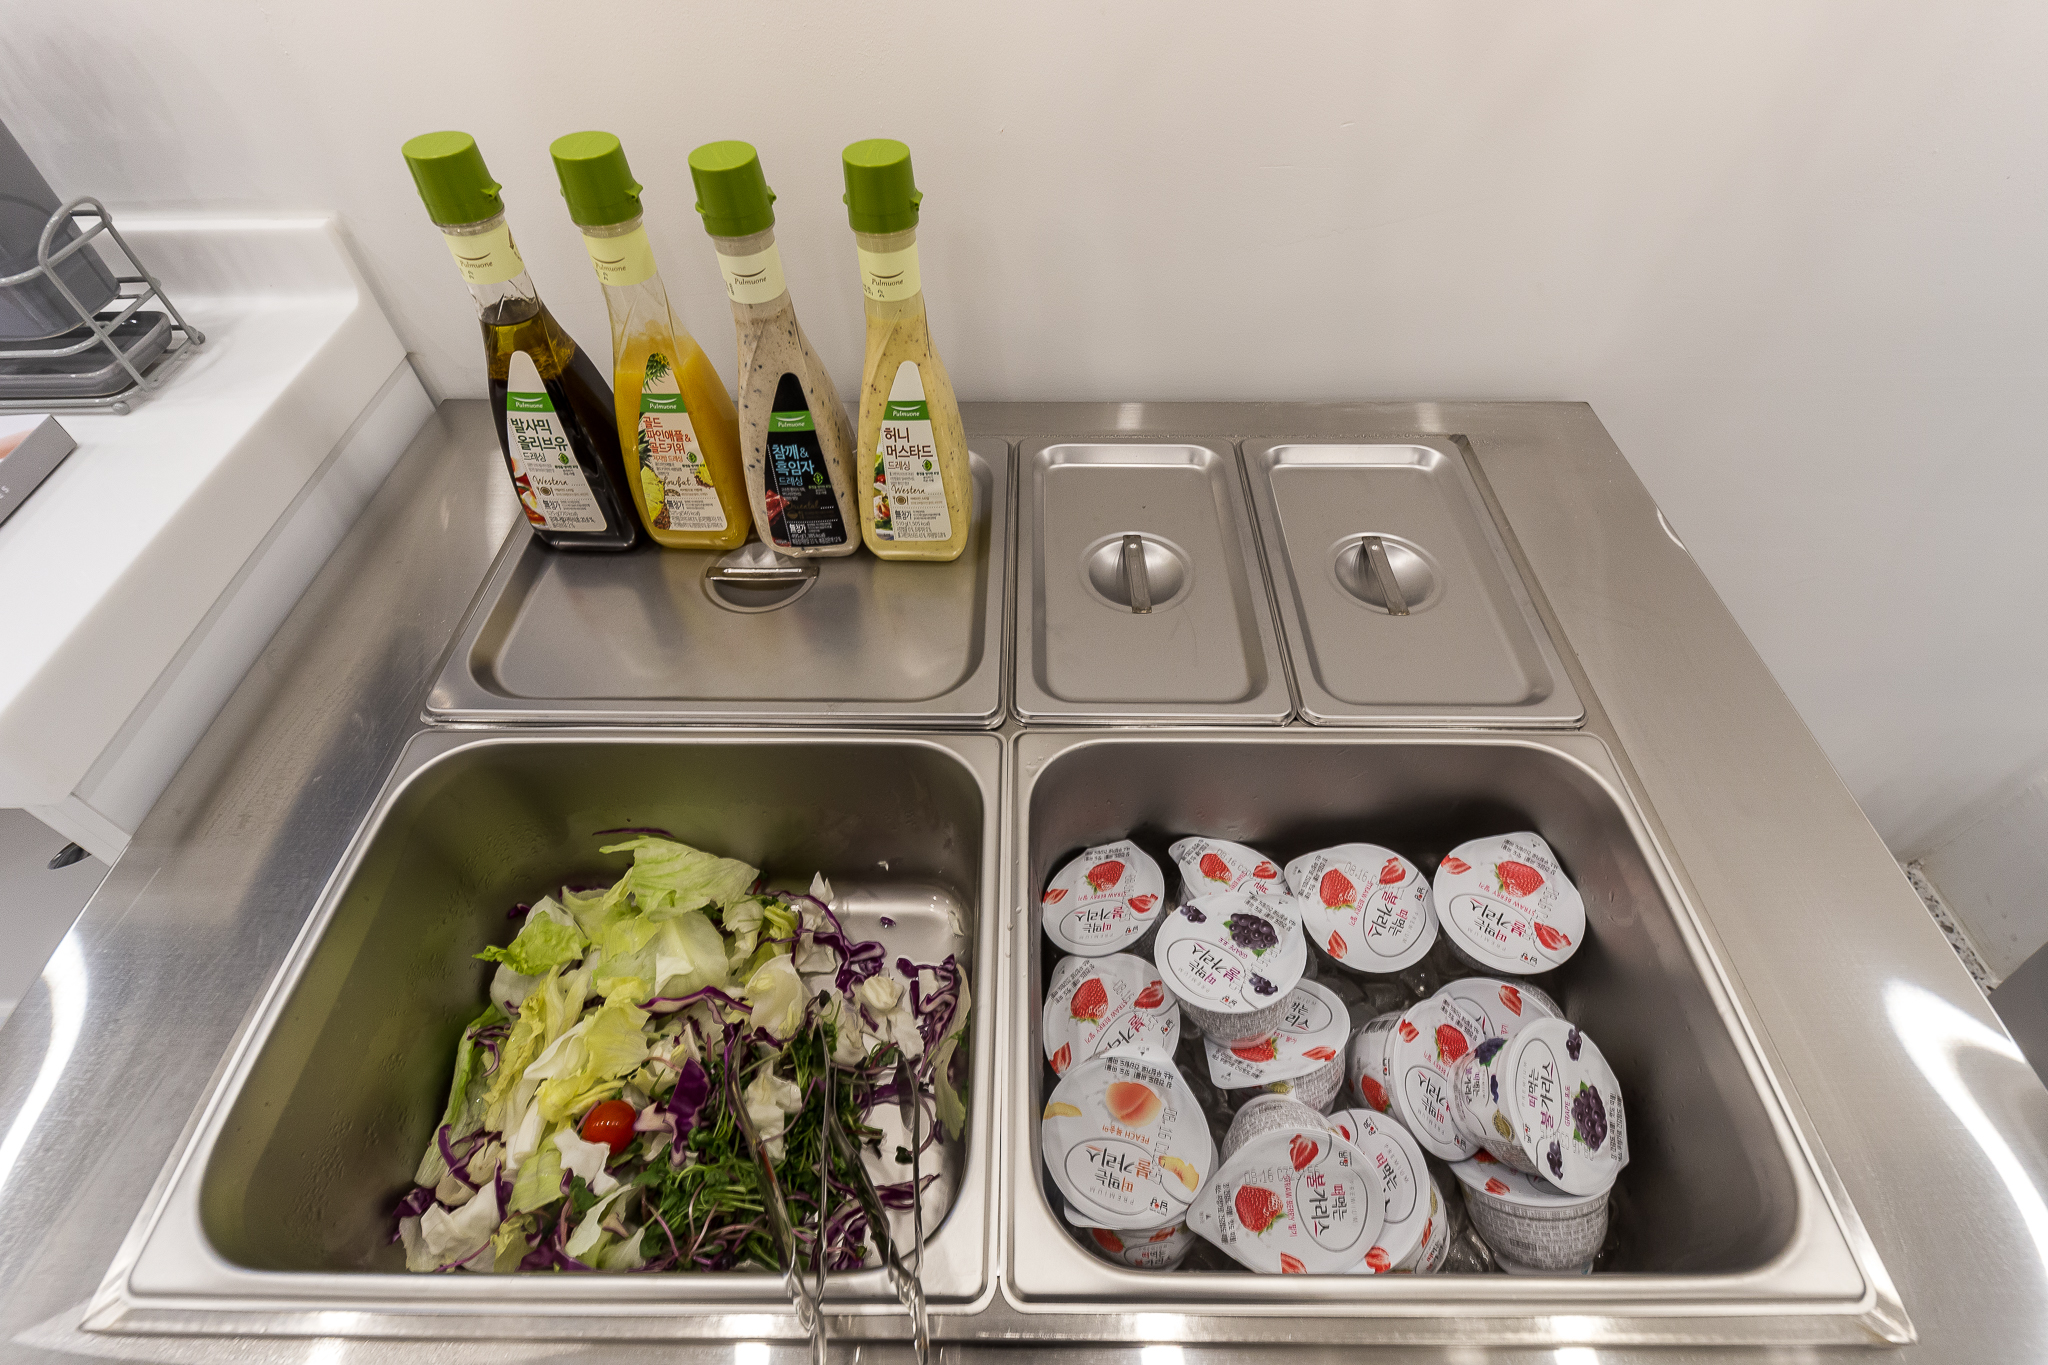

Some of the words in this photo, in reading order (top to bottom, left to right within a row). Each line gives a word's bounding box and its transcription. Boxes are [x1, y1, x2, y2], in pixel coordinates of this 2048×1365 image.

[734, 277, 766, 285] Pulmuone
[510, 418, 552, 434] 발사믹
[643, 417, 663, 429] 골드
[518, 436, 568, 451] 올리브유
[884, 428, 910, 443] 허니
[523, 452, 546, 462] 드레싱
[650, 442, 685, 454] 골드키위
[886, 445, 933, 460] 머스타드
[776, 460, 814, 475] 흑임자
[888, 461, 910, 470] 드레싱
[532, 475, 568, 486] Western
[779, 476, 803, 486] 드레싱
[891, 484, 925, 494] Western
[1073, 906, 1123, 921] 불가리스
[1368, 891, 1398, 936] 불가리스
[1387, 908, 1408, 935] 떠먹는
[1470, 898, 1526, 937] 불가리스
[1474, 916, 1506, 941] 떠먹는
[1192, 942, 1240, 981] 불가리스
[1189, 960, 1216, 985] 떠먹는
[1283, 1012, 1311, 1031] 리스
[1418, 1071, 1448, 1104] 가리스
[1527, 1067, 1538, 1107] 떠먹는
[1540, 1061, 1553, 1129] 불가리스
[1421, 1094, 1444, 1123] 떠먹는
[1124, 1130, 1150, 1144] PEACH
[1085, 1145, 1152, 1179] 불가리스
[1376, 1152, 1396, 1191] 떠먹는
[1094, 1168, 1134, 1192] 떠먹는
[1088, 1186, 1134, 1205] PREMIUM
[1306, 1173, 1330, 1237] 불가리스
[1329, 1183, 1348, 1221] 떠먹는
